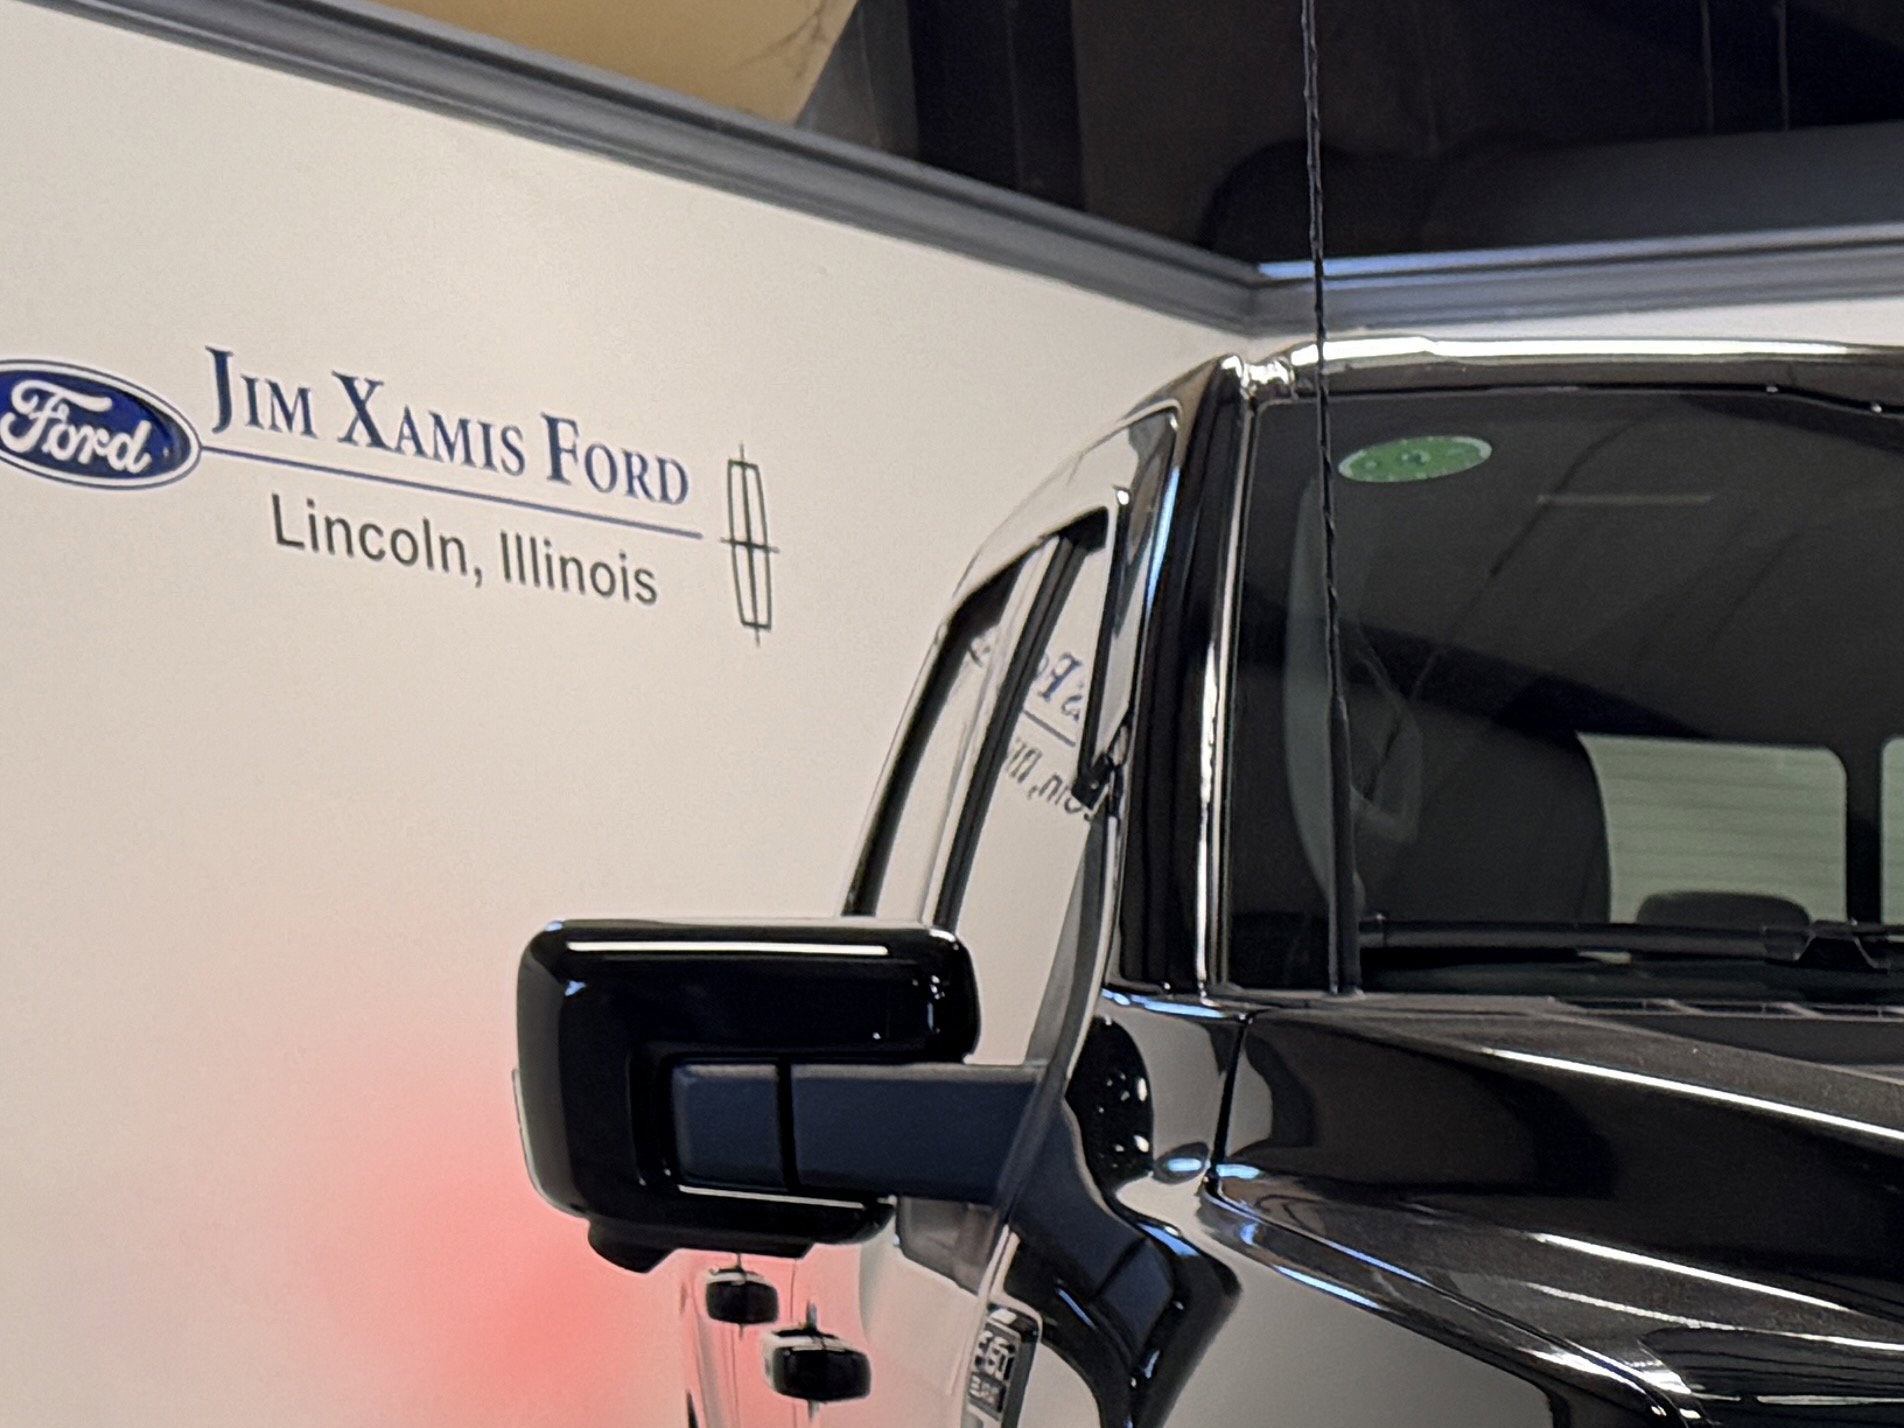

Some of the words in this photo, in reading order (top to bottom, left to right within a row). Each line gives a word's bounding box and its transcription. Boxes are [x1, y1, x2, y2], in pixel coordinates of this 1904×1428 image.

[0, 379, 154, 474] Ford
[204, 346, 316, 438] JIM
[331, 370, 526, 477] XAMIS
[541, 413, 689, 505] FORD
[271, 492, 483, 588] Lincoln,
[500, 531, 658, 605] Illinois
